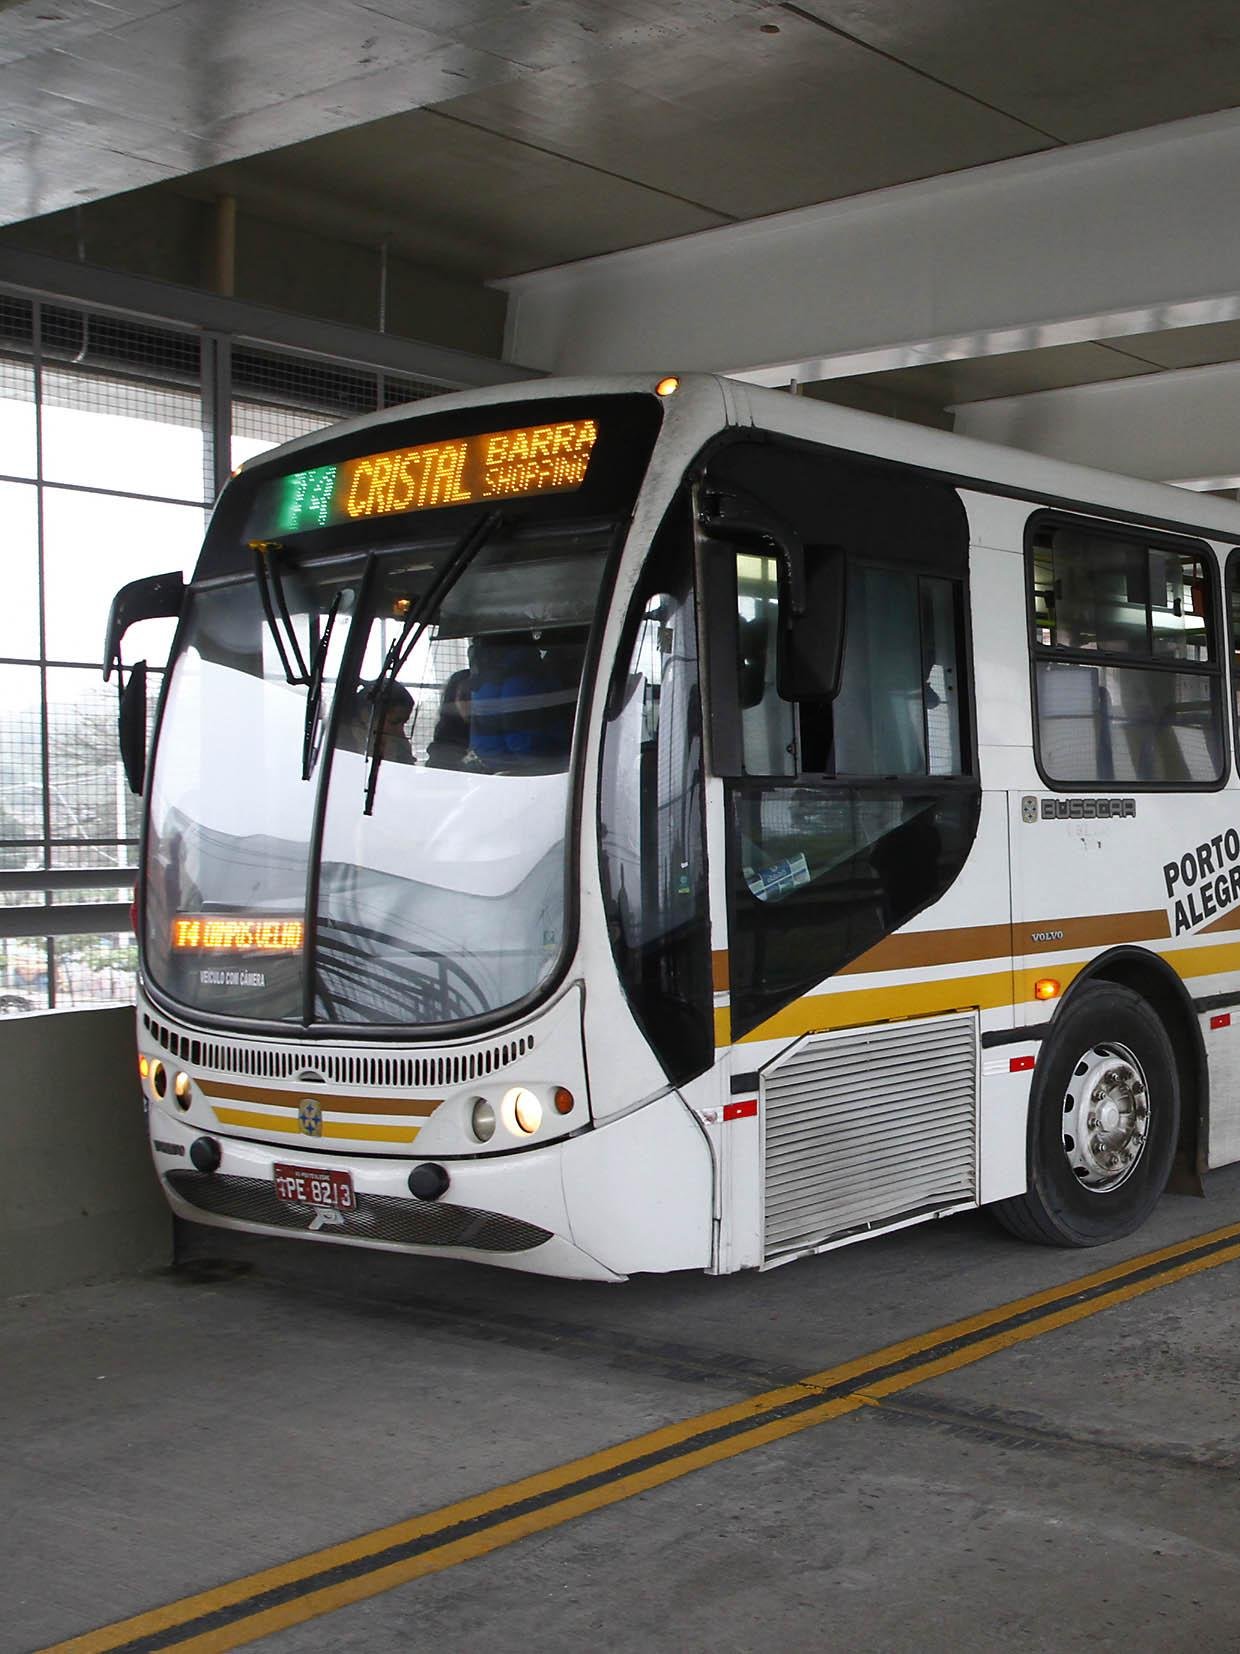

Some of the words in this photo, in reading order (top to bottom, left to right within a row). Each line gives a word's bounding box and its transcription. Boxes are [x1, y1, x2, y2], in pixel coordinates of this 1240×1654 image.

[486, 420, 597, 466] BARRA
[347, 443, 471, 517] CRISTAL
[483, 453, 590, 495] SHOPPING
[1041, 798, 1136, 820] BUSSCAR
[1163, 828, 1240, 898] PORTO
[177, 921, 200, 947] T4
[1031, 930, 1064, 942] VOLVO
[226, 971, 239, 986] COM
[311, 1181, 351, 1207] 8213
